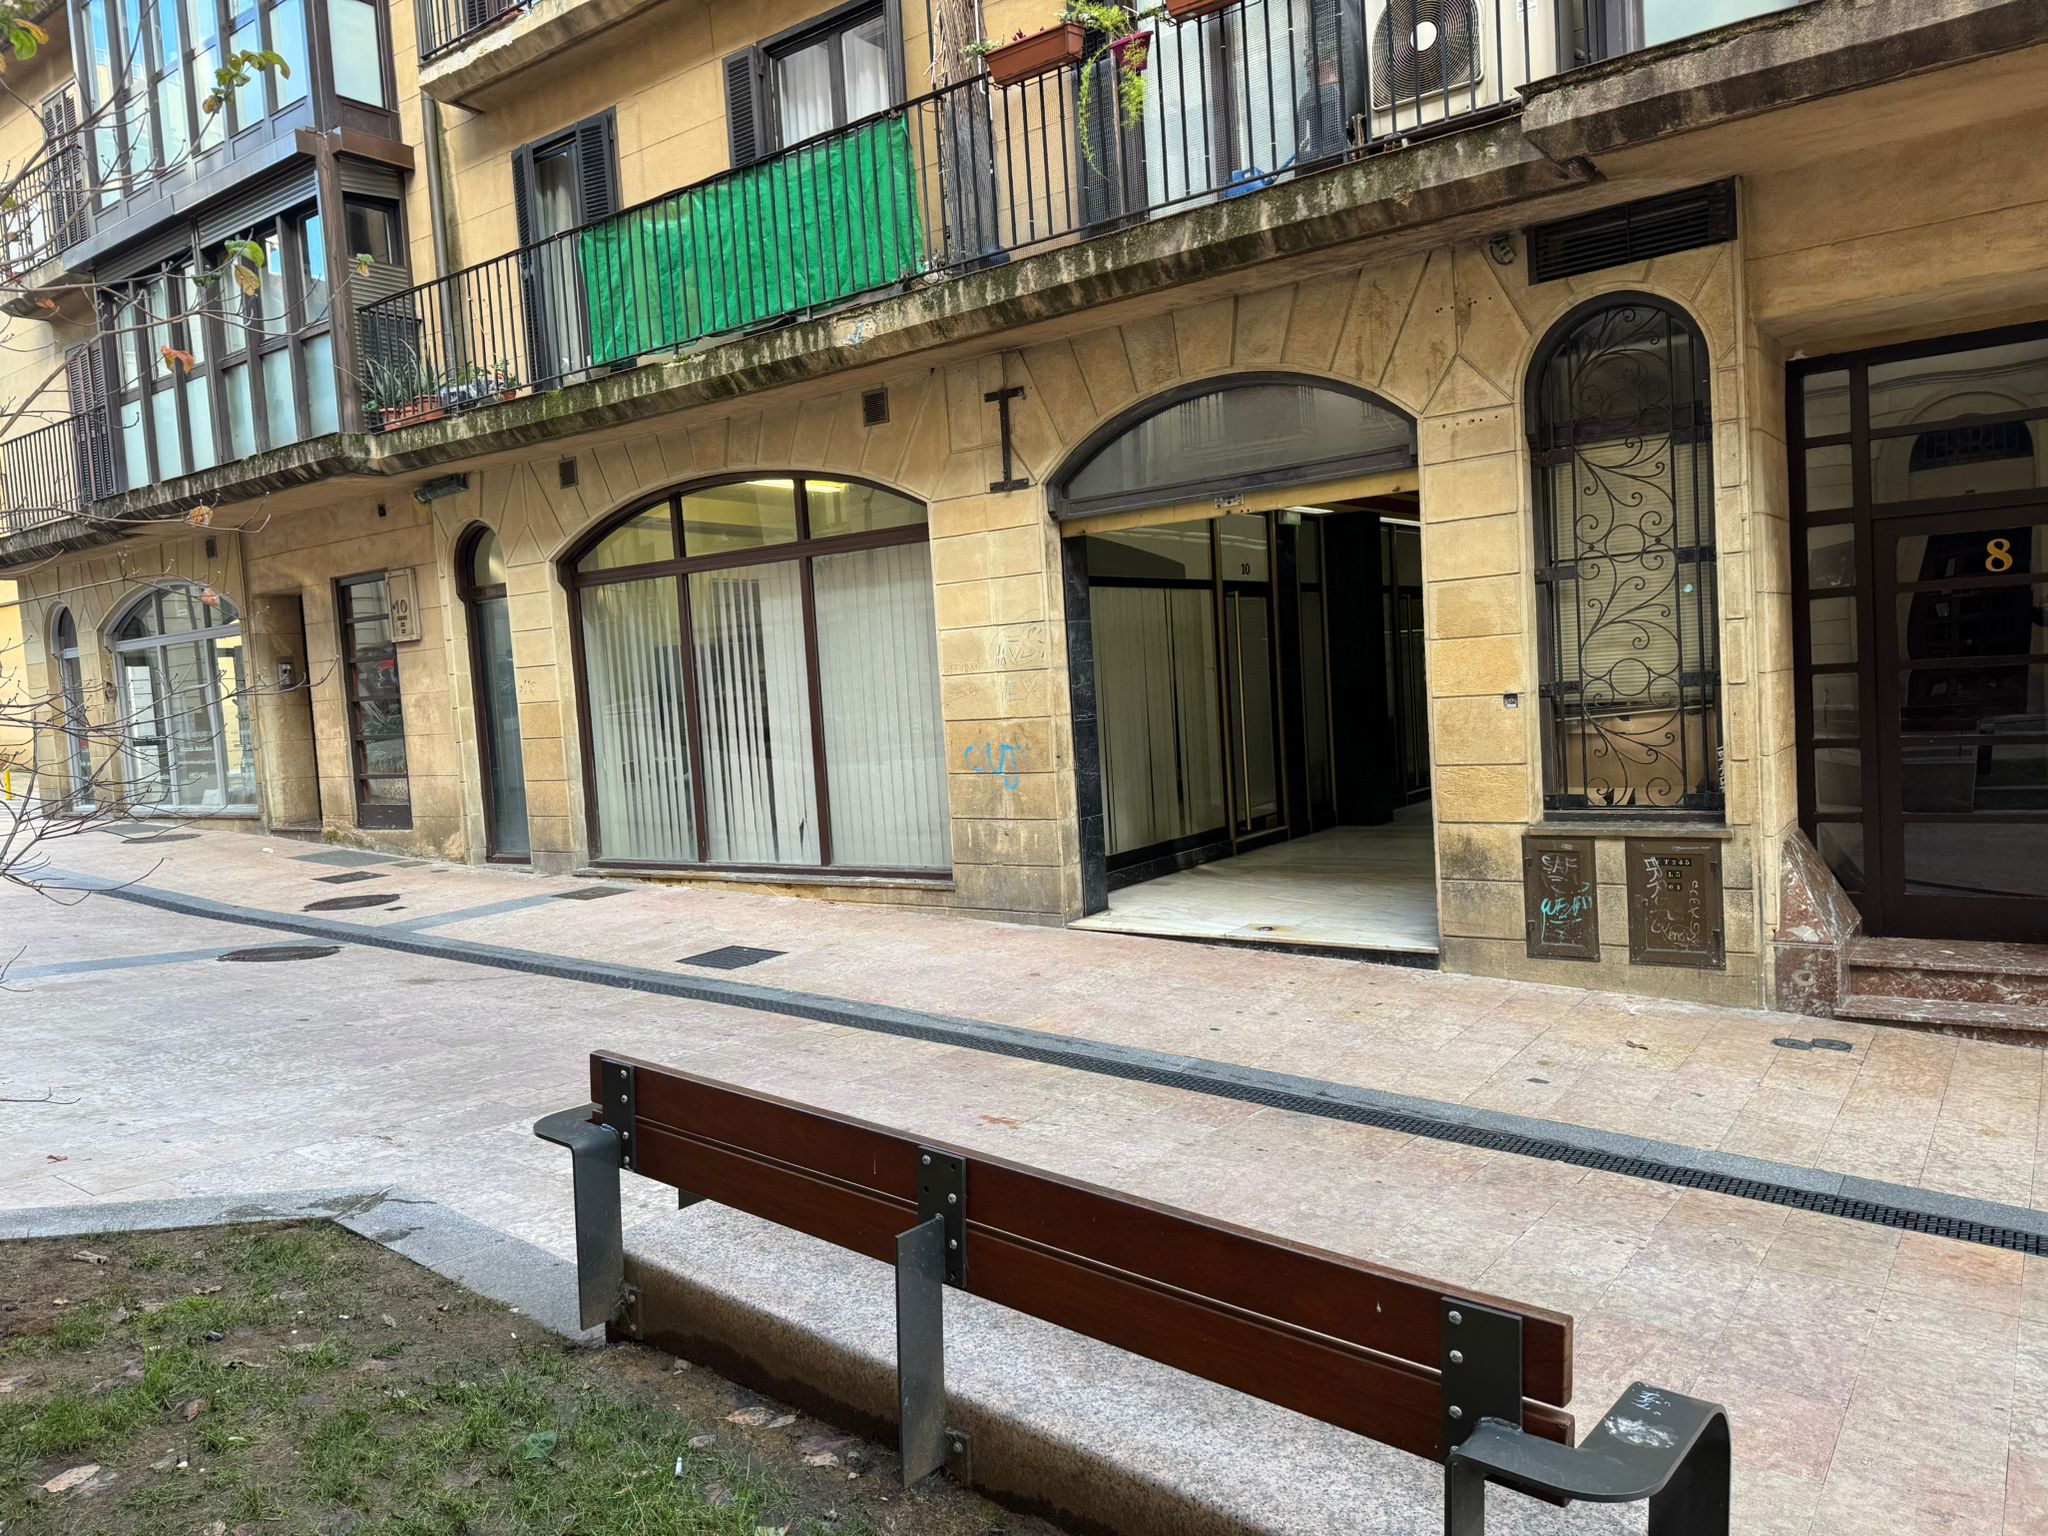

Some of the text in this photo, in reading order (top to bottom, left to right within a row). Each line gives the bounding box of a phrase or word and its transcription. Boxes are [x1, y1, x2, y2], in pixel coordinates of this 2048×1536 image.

[1985, 538, 2013, 572] 8
[1241, 563, 1251, 575] 10
[392, 599, 408, 614] 10
